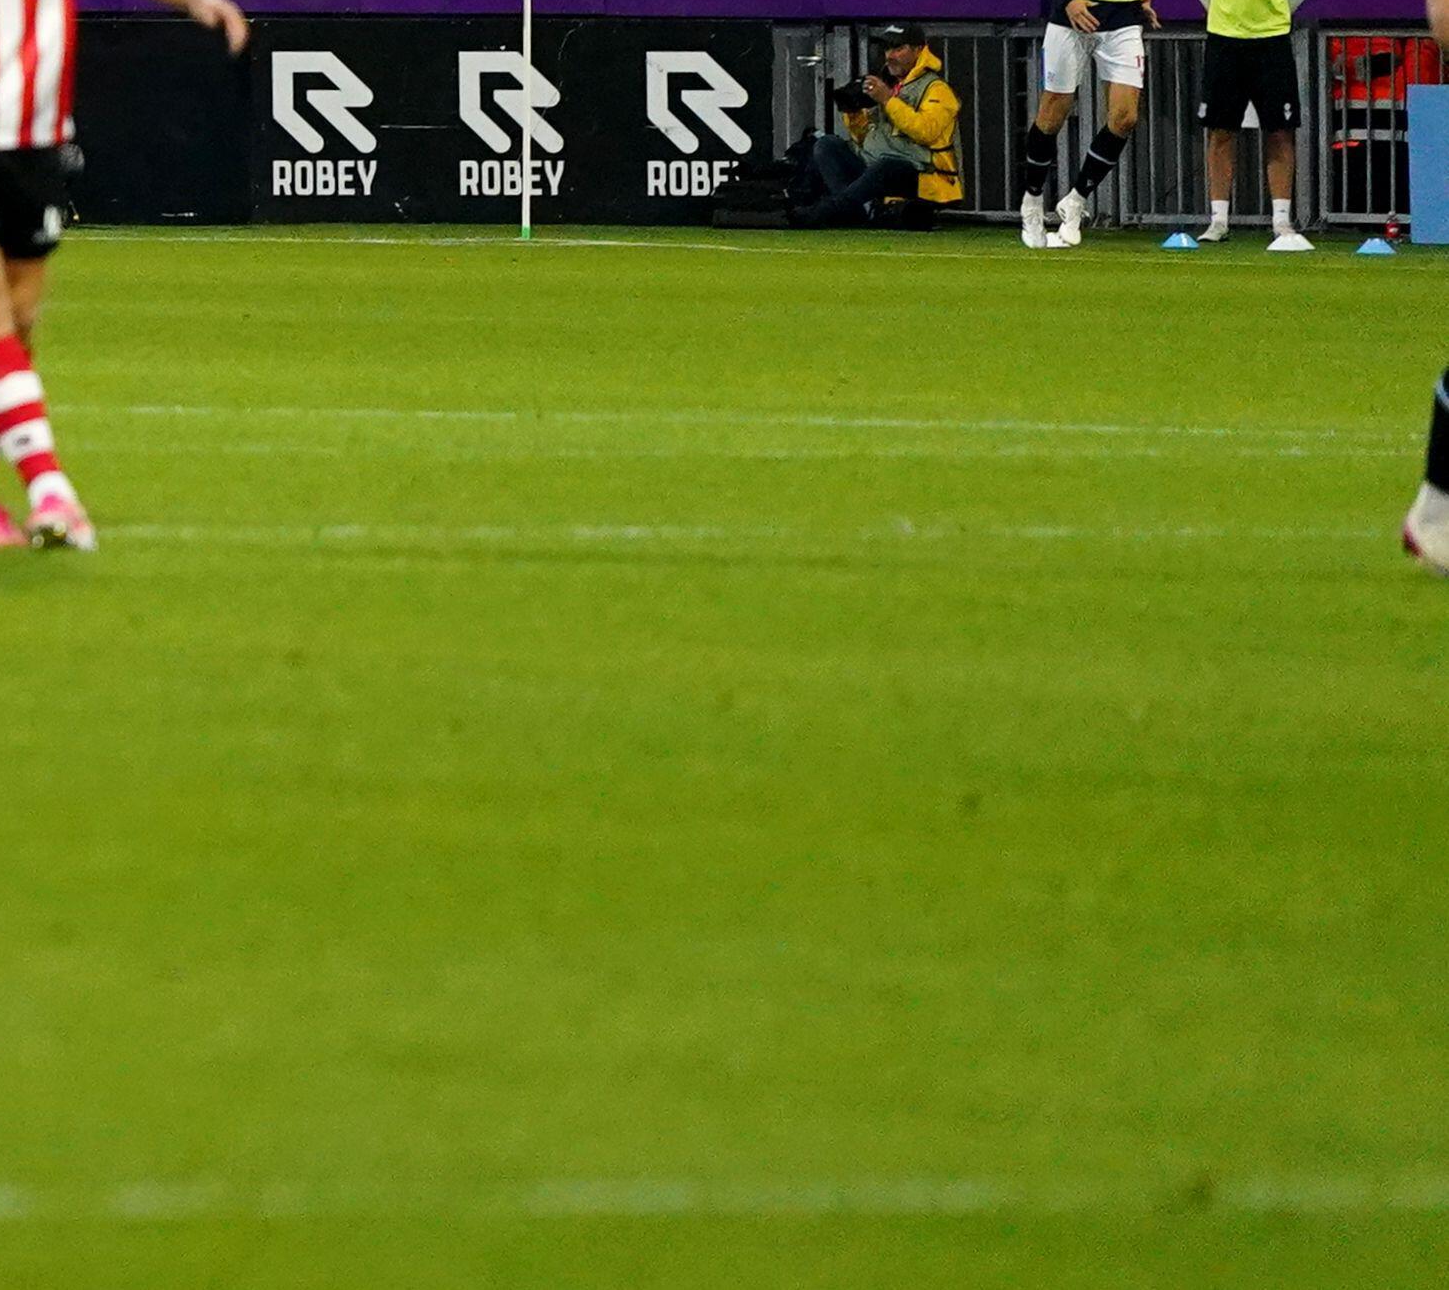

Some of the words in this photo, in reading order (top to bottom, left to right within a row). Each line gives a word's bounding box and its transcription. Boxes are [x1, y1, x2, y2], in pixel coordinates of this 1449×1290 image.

[272, 159, 378, 197] ROBEY
[459, 159, 565, 197] ROBEY
[647, 159, 740, 197] ROBE
